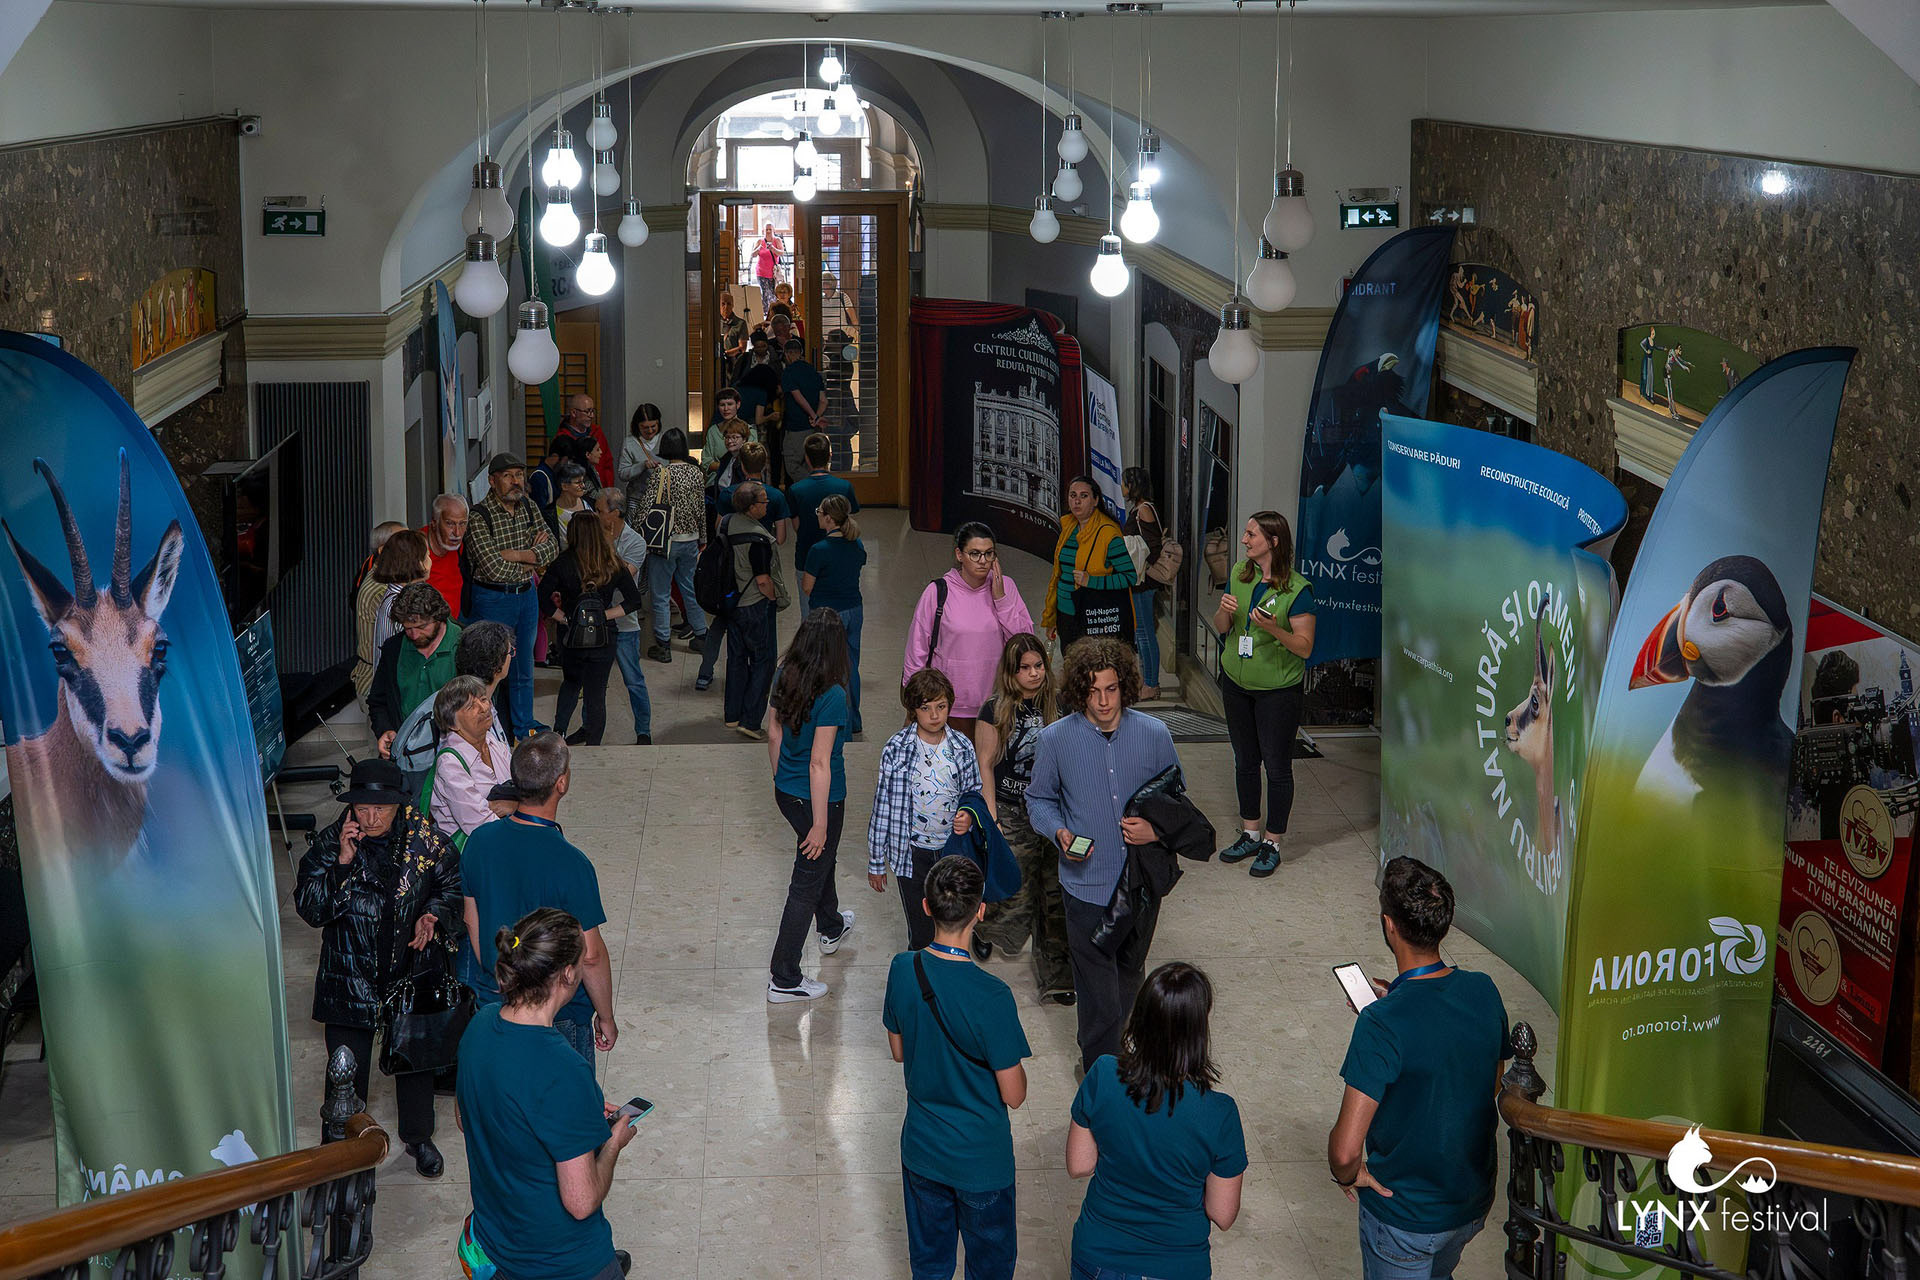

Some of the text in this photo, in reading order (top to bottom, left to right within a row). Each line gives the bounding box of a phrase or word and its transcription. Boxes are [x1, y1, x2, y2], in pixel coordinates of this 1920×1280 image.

[973, 343, 1049, 367] CENTRUL CULTURAL
[996, 358, 1025, 373] REDUTA
[1387, 439, 1429, 462] CONSERVARE
[1429, 452, 1461, 470] PĂDURI
[1480, 465, 1539, 495] RECONSTRUCȚIE
[1538, 485, 1571, 511] ECOLOGICĂ
[1300, 559, 1382, 585] LYNX festi
[1085, 607, 1120, 617] Cluj-Napoca
[1314, 596, 1382, 614] w.lynxfestiv
[1402, 647, 1453, 683] www.carpathia.org
[1476, 619, 1513, 820] NATURĂ
[1502, 590, 1525, 645] ȘI
[1527, 580, 1576, 704] OAMENI
[1002, 778, 1029, 791] SUPE
[1806, 862, 1837, 893] IUBIM
[1838, 884, 1896, 937] BRAȘOVUL
[1807, 878, 1821, 897] TV
[1823, 855, 1898, 920] TELEVIZIUNEA
[1802, 1035, 1832, 1058] 2281
